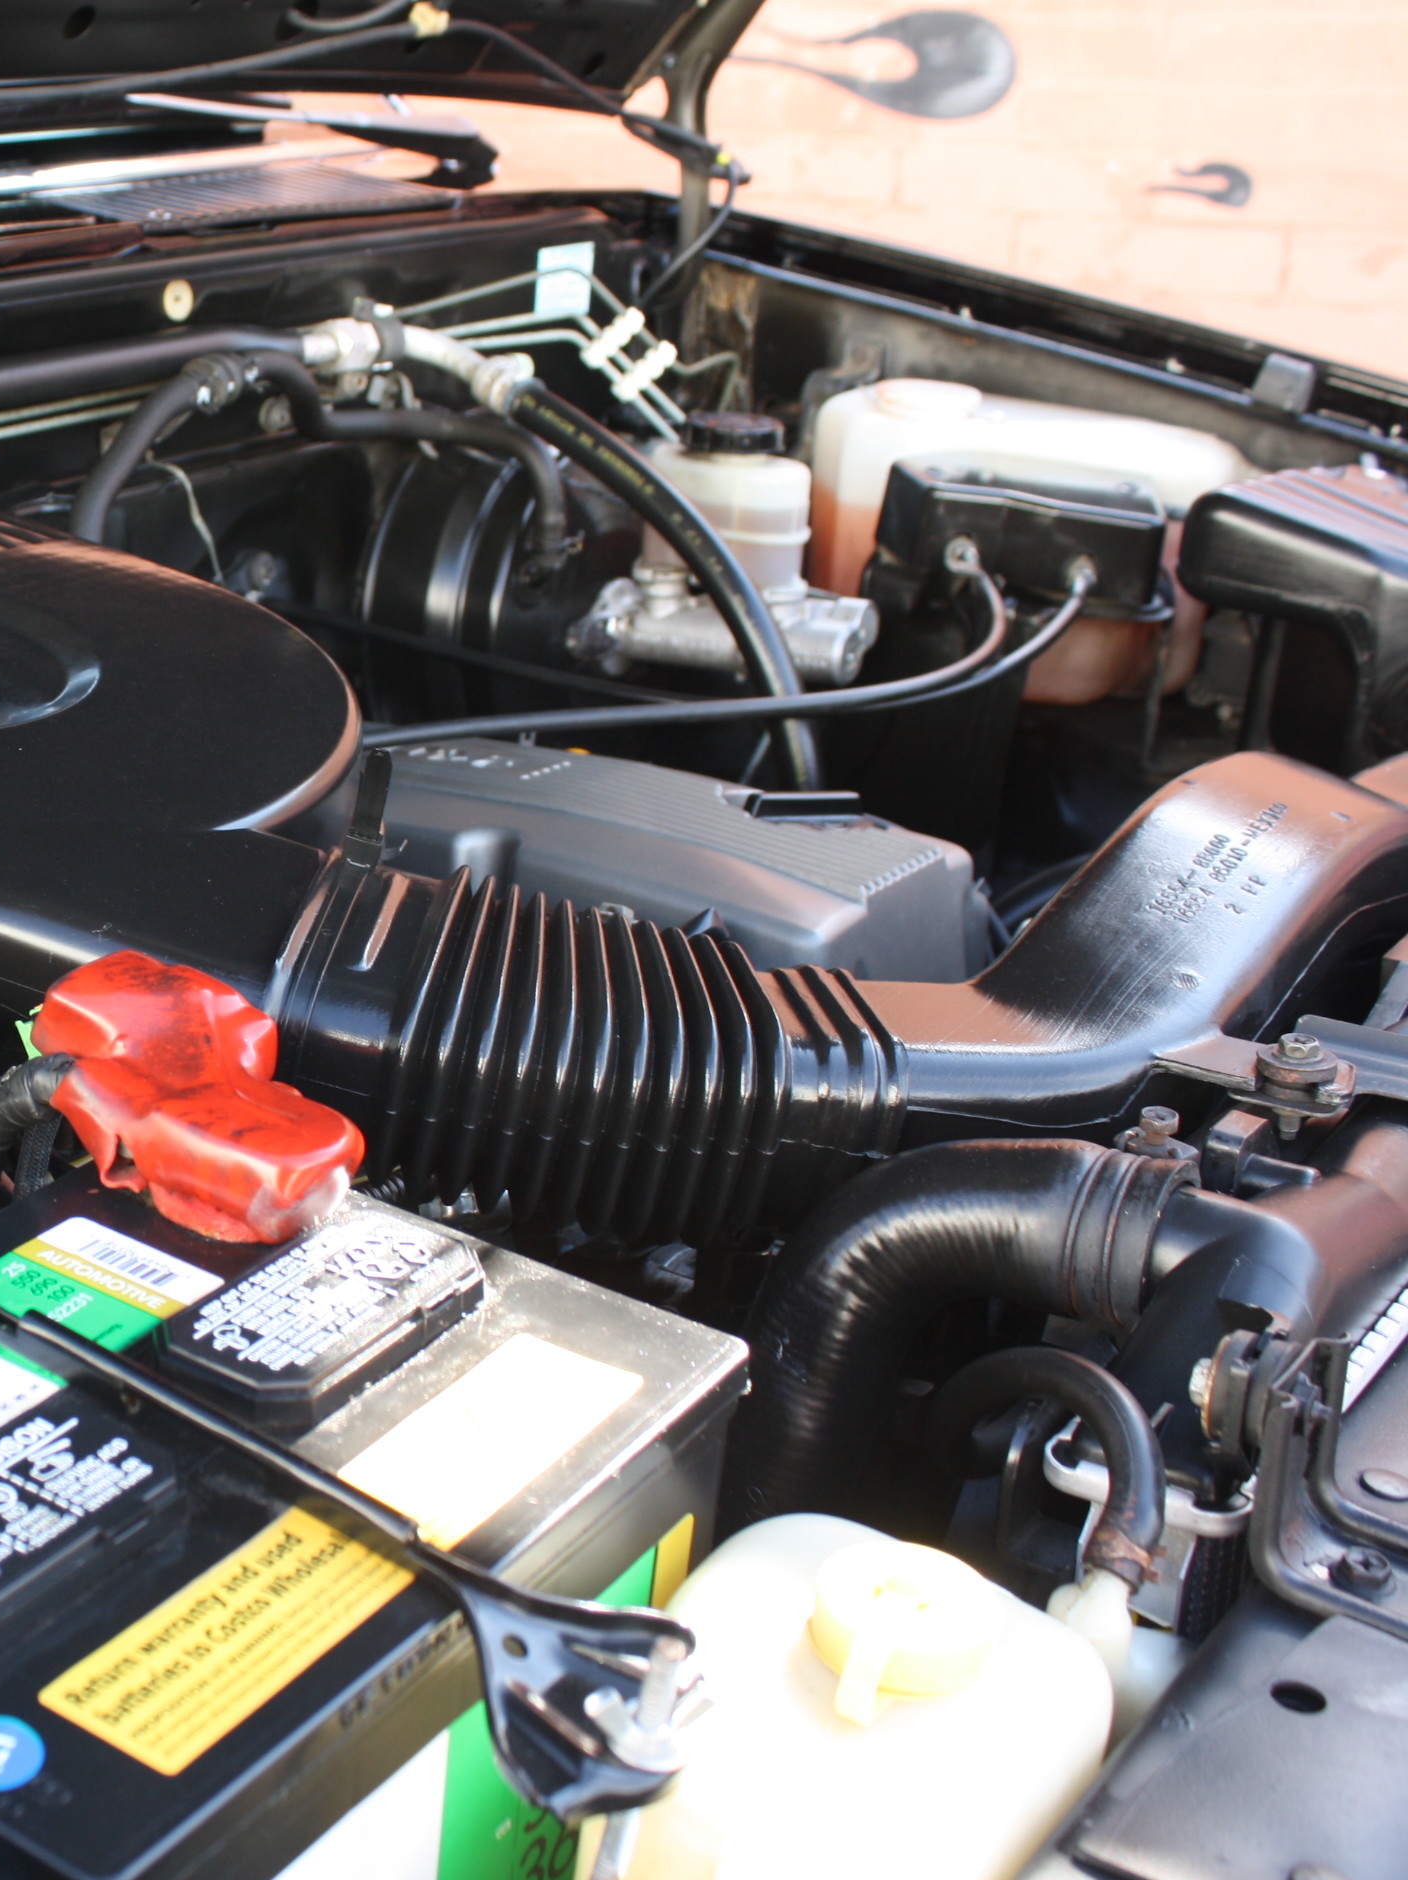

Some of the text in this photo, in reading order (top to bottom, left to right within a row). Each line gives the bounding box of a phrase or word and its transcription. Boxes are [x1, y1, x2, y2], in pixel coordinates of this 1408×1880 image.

[1, 1261, 27, 1278] 25
[10, 1269, 42, 1290] 550
[36, 1248, 168, 1311] AUTOMOTIVE
[30, 1277, 58, 1297] 690
[46, 1284, 76, 1303] 100
[65, 1655, 140, 1709] Return
[139, 1591, 227, 1656] warranty
[222, 1564, 259, 1596] and
[255, 1530, 303, 1571] used
[98, 1659, 192, 1727] batteries
[191, 1642, 212, 1663] to
[204, 1597, 271, 1646] Costco
[268, 1526, 358, 1598] Wholesal
